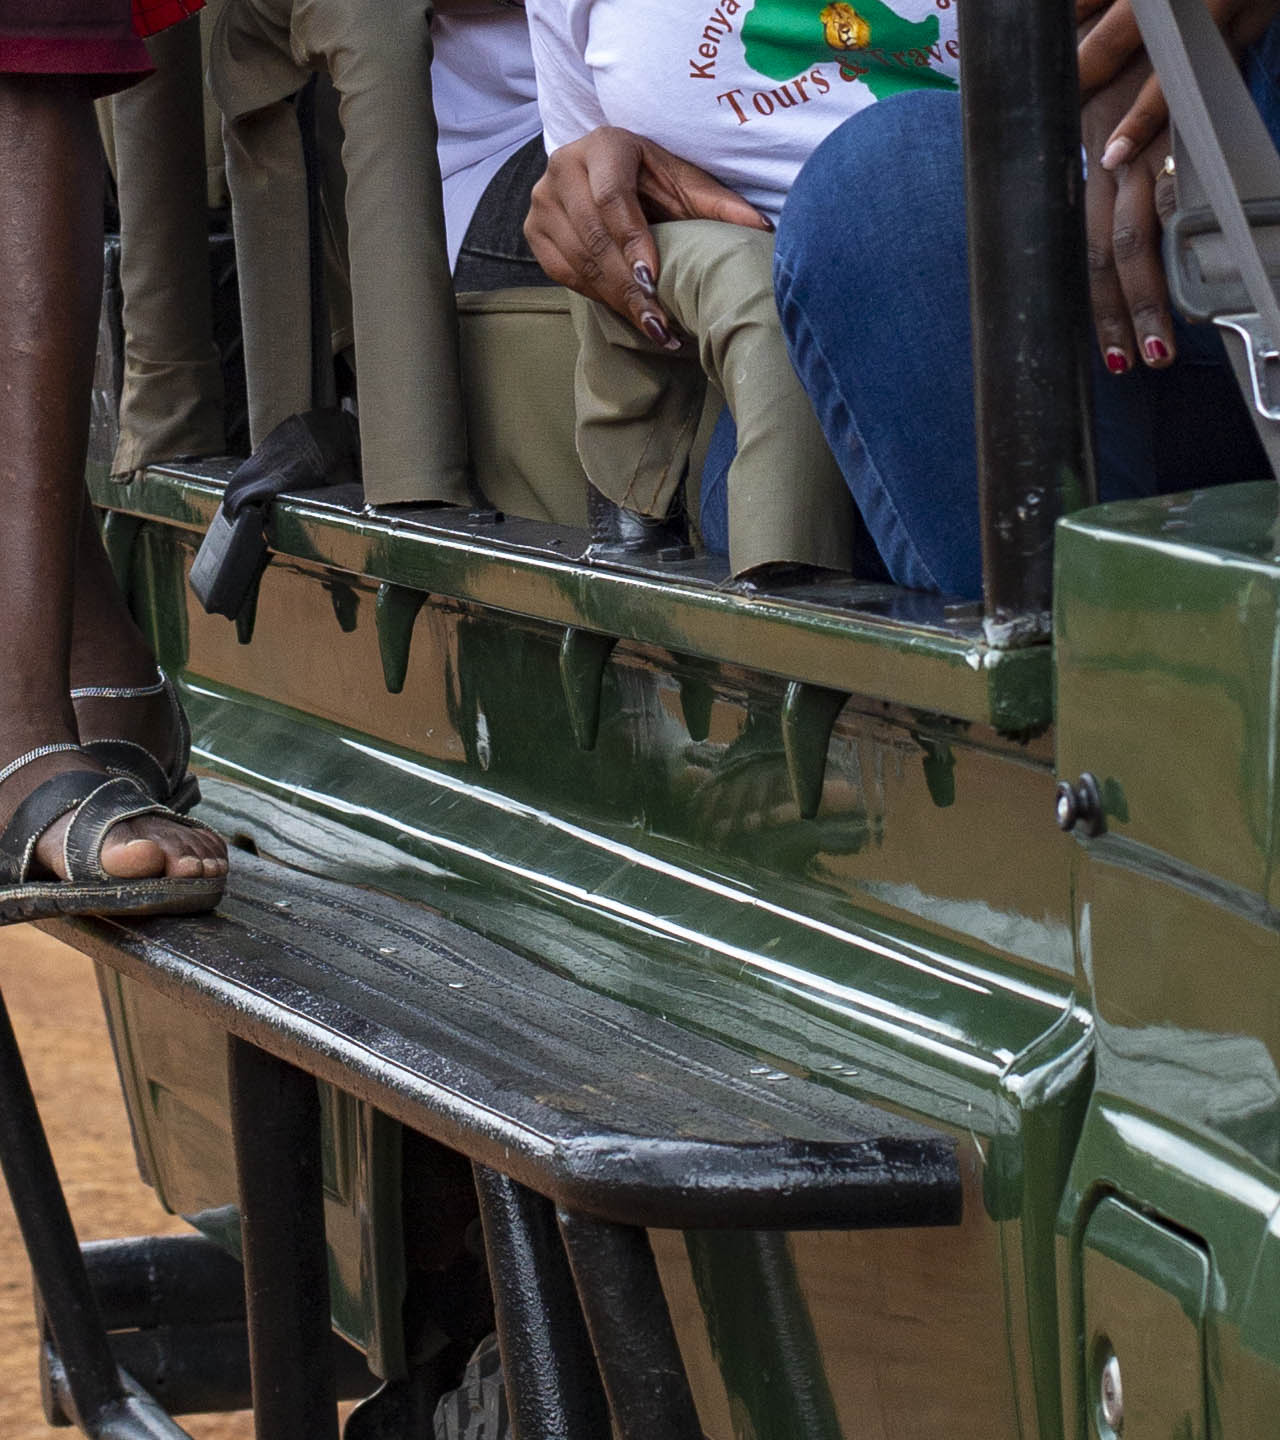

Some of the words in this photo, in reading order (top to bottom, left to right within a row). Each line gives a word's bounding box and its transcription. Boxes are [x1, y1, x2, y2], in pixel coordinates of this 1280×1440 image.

[716, 67, 830, 126] Tours
[835, 55, 869, 82] &
[862, 38, 959, 70] Trave
